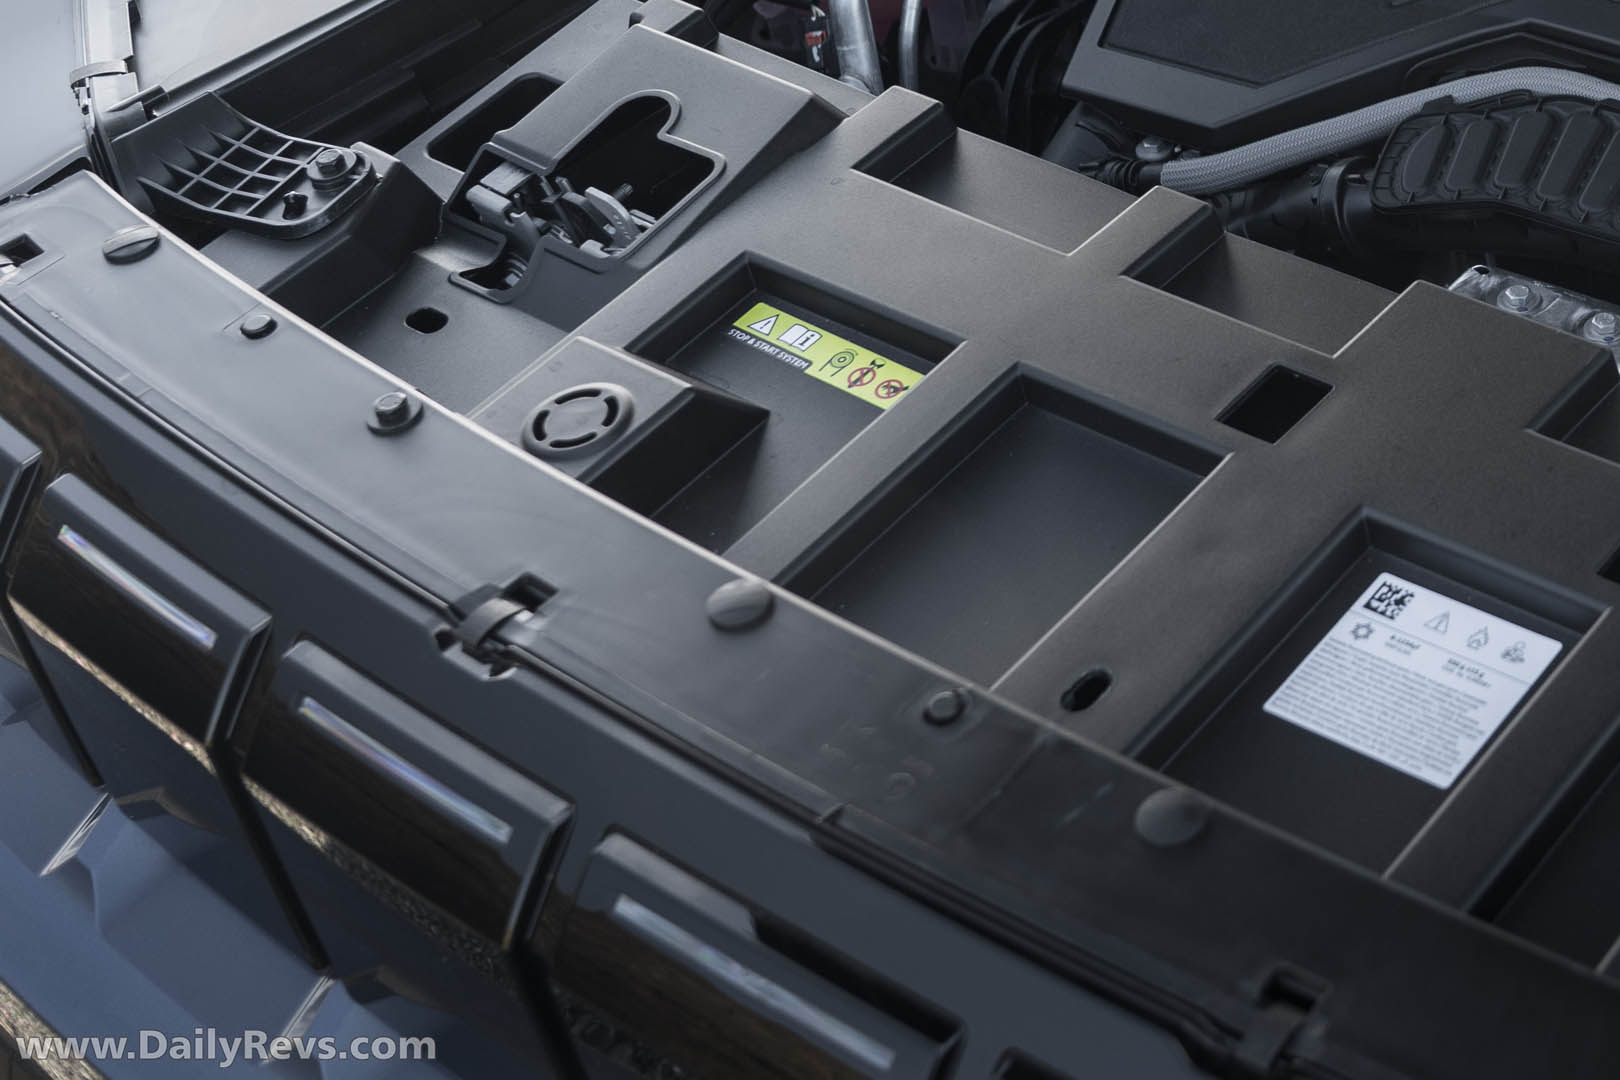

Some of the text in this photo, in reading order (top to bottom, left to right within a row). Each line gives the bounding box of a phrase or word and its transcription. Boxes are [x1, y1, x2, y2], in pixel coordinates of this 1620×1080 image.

[728, 328, 751, 341] STOP
[752, 340, 780, 356] START
[777, 351, 810, 369] SYSTEM
